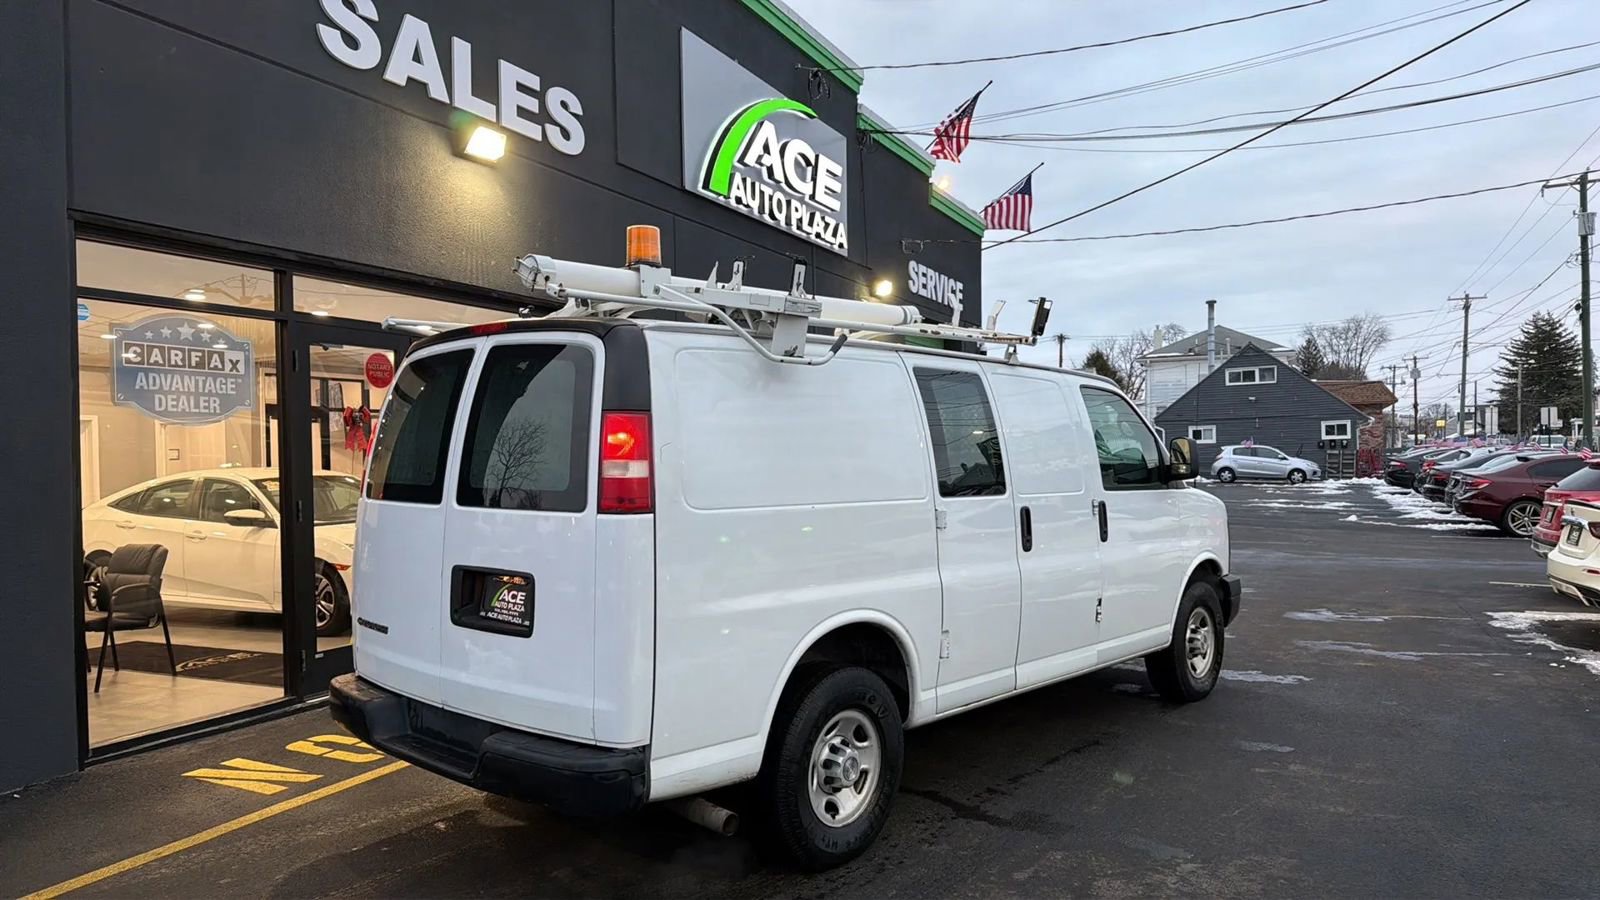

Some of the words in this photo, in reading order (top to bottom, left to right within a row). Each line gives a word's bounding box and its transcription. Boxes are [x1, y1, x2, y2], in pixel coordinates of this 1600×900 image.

[316, 0, 586, 156] SALES
[742, 119, 843, 213] ACE
[730, 171, 787, 224] AUTO
[790, 198, 849, 250] PLAZA
[908, 260, 964, 313] SERVICE
[126, 344, 242, 374] CARFAX
[369, 370, 391, 378] PUBLIC
[154, 394, 221, 414] DEALER
[498, 589, 526, 603] ACE
[508, 603, 525, 612] PLAZA
[181, 734, 385, 796] NO
